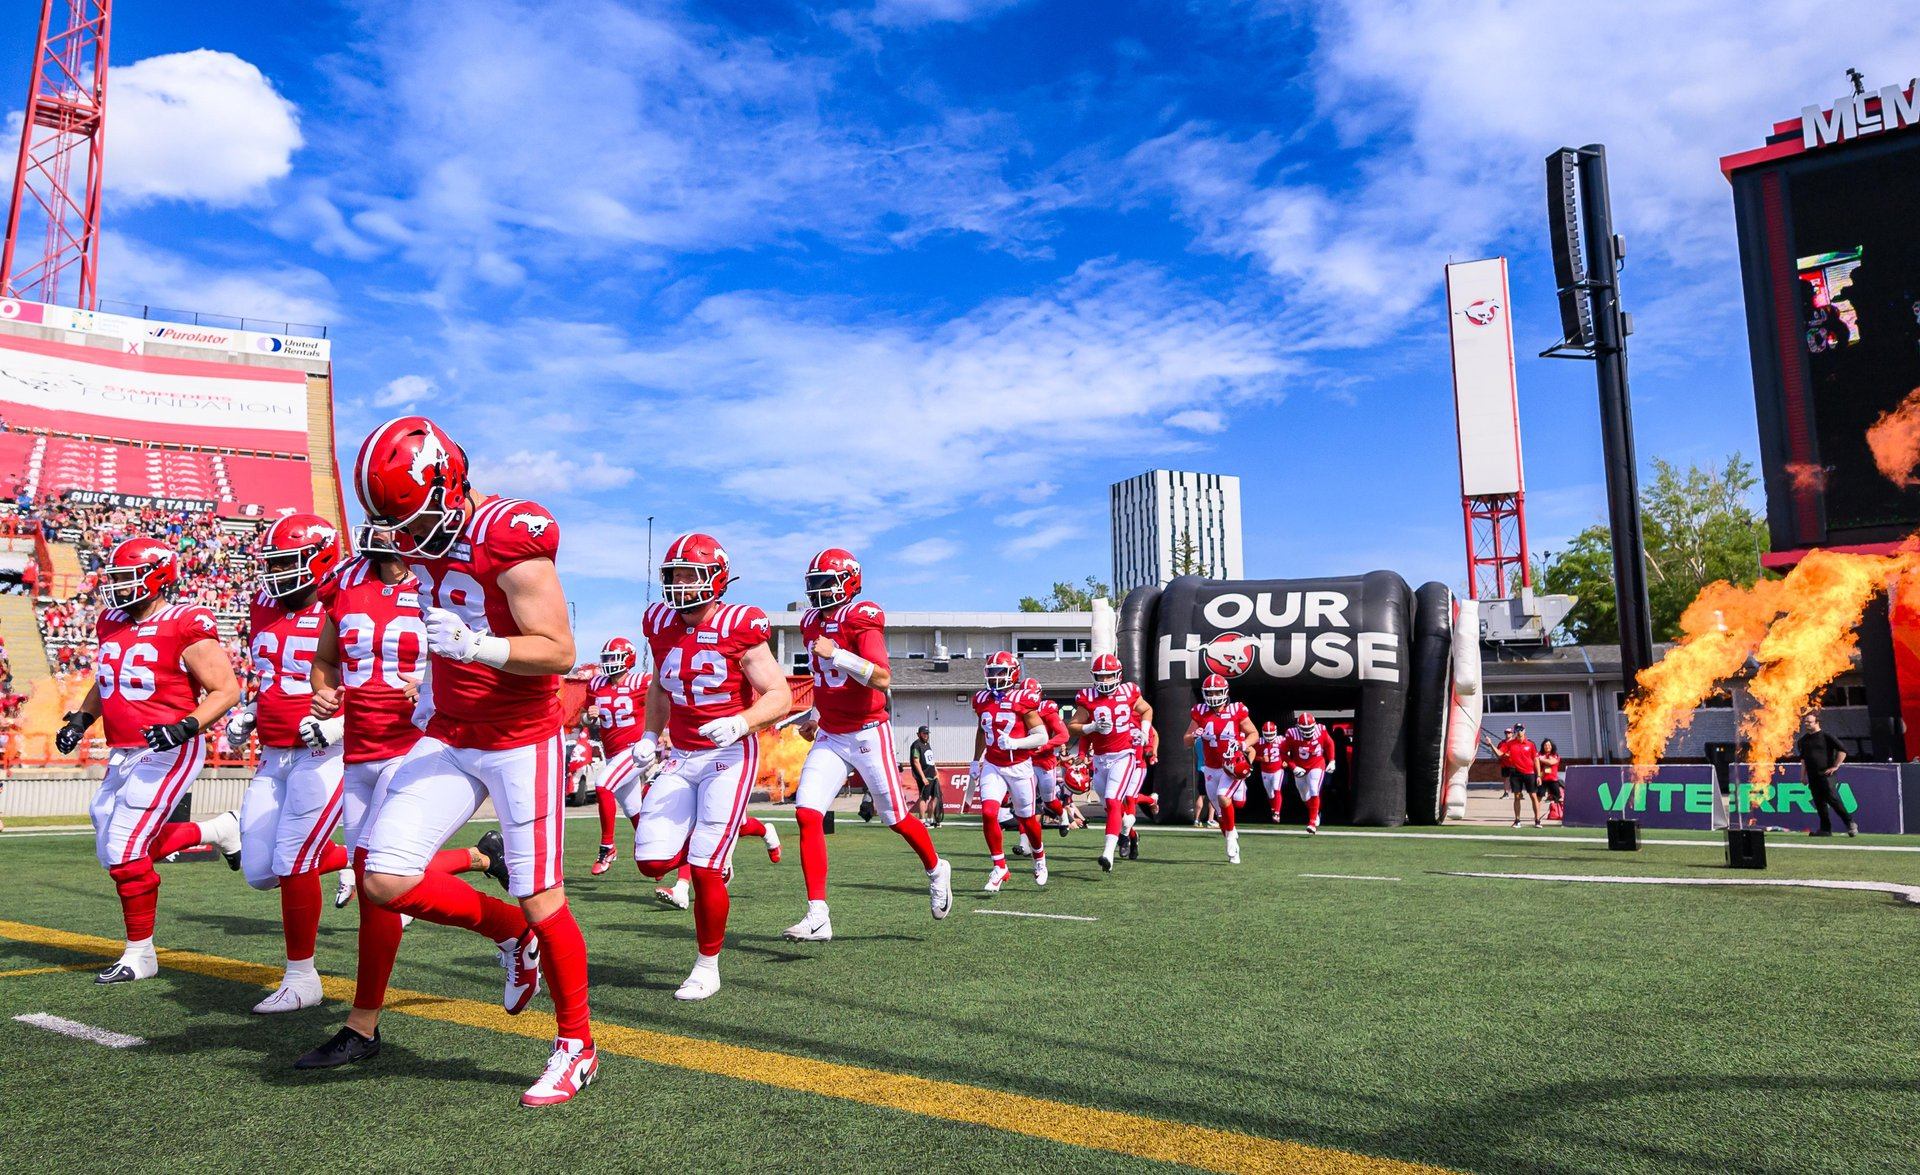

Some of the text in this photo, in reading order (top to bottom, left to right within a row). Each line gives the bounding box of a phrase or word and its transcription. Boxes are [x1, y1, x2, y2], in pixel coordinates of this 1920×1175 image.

[164, 328, 228, 345] Purolator
[283, 347, 321, 358] Rentals
[284, 339, 319, 349] United
[71, 491, 214, 513] QUICK SIX STABLE
[1203, 591, 1350, 629] OUR
[252, 631, 320, 695] 65
[339, 613, 428, 689] 30
[97, 641, 158, 700] 66
[660, 646, 732, 706] 42
[594, 695, 636, 729] 52
[1202, 721, 1236, 748] 44
